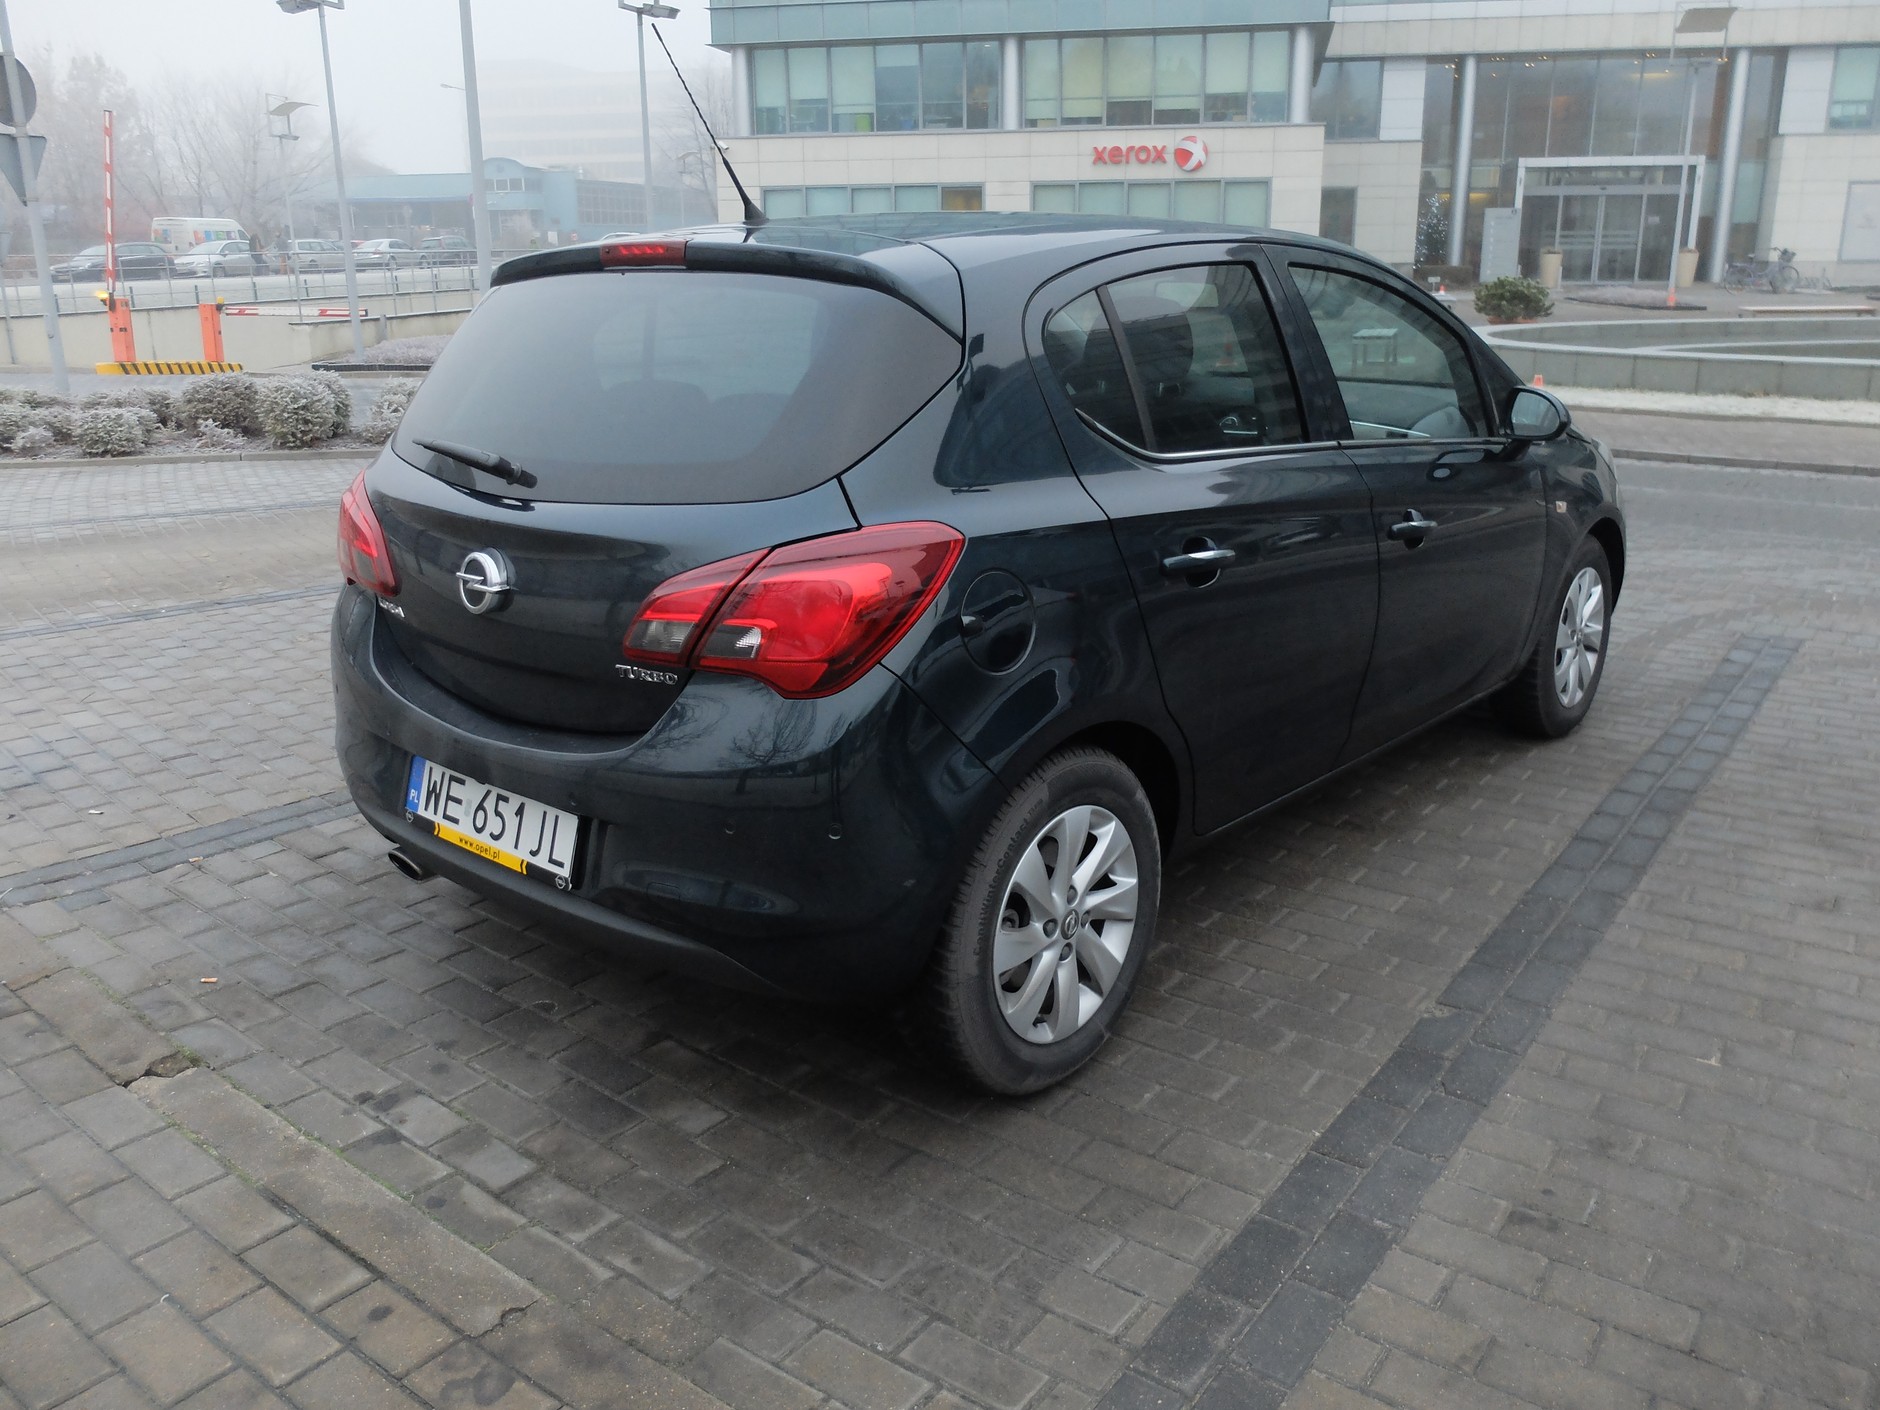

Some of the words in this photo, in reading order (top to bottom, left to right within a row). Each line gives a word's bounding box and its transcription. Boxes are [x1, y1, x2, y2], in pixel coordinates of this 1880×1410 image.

[1093, 145, 1168, 165] xerox
[615, 664, 679, 685] TURBO
[409, 789, 419, 804] PL
[423, 765, 467, 826] WE
[458, 836, 501, 860] www.opel.pl
